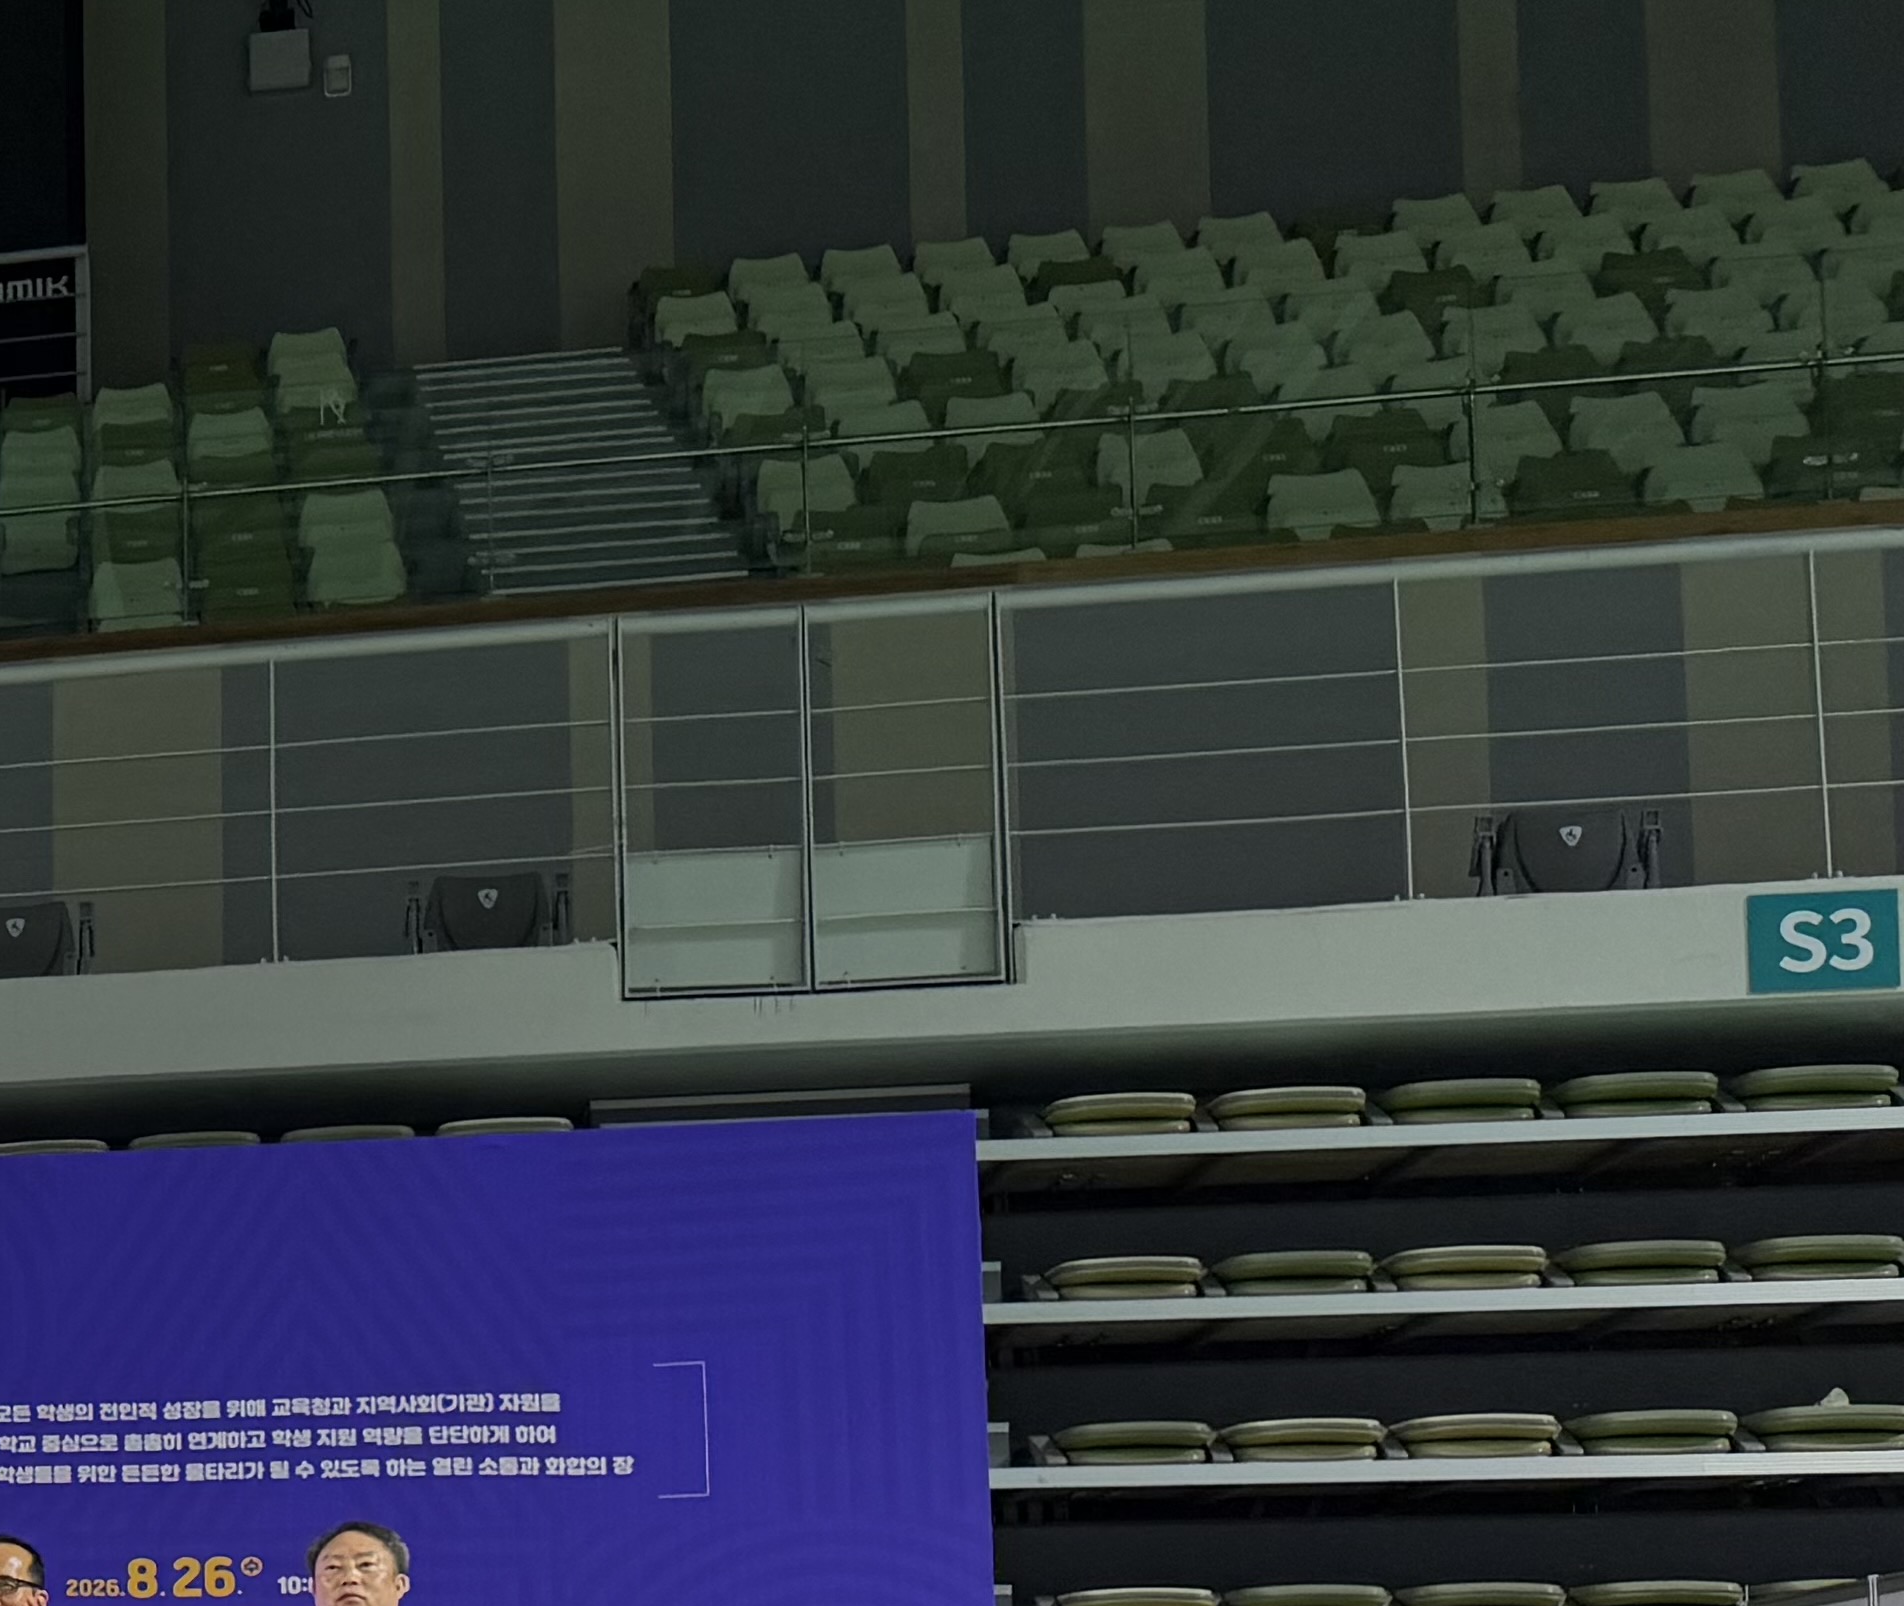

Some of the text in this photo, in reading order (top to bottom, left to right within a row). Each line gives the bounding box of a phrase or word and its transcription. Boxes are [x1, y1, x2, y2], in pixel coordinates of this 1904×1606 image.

[1778, 907, 1874, 973] S3
[36, 1402, 93, 1422] 학생의
[99, 1401, 158, 1421] 전인적
[162, 1400, 221, 1420] 성장을
[226, 1399, 266, 1418] 위해
[271, 1397, 352, 1417] 교육청과
[356, 1393, 493, 1416] 지역사회(기관)
[42, 1434, 119, 1452] 중심으로
[188, 1430, 267, 1450] 연계하고
[271, 1428, 312, 1448] 학생
[317, 1427, 357, 1447] 지원
[362, 1426, 423, 1446] 역량을
[428, 1425, 510, 1445] 단단하게
[515, 1424, 557, 1443] 하여
[77, 1464, 117, 1484] 위한
[121, 1463, 181, 1483] 든든한
[185, 1461, 265, 1482] 울타리가
[294, 1460, 315, 1479] 수
[320, 1458, 380, 1479] 있도록
[386, 1458, 426, 1477] 하는
[432, 1457, 474, 1476] 열린
[478, 1456, 540, 1476] 소통과
[545, 1455, 607, 1476] 화합의
[613, 1455, 634, 1476] 장
